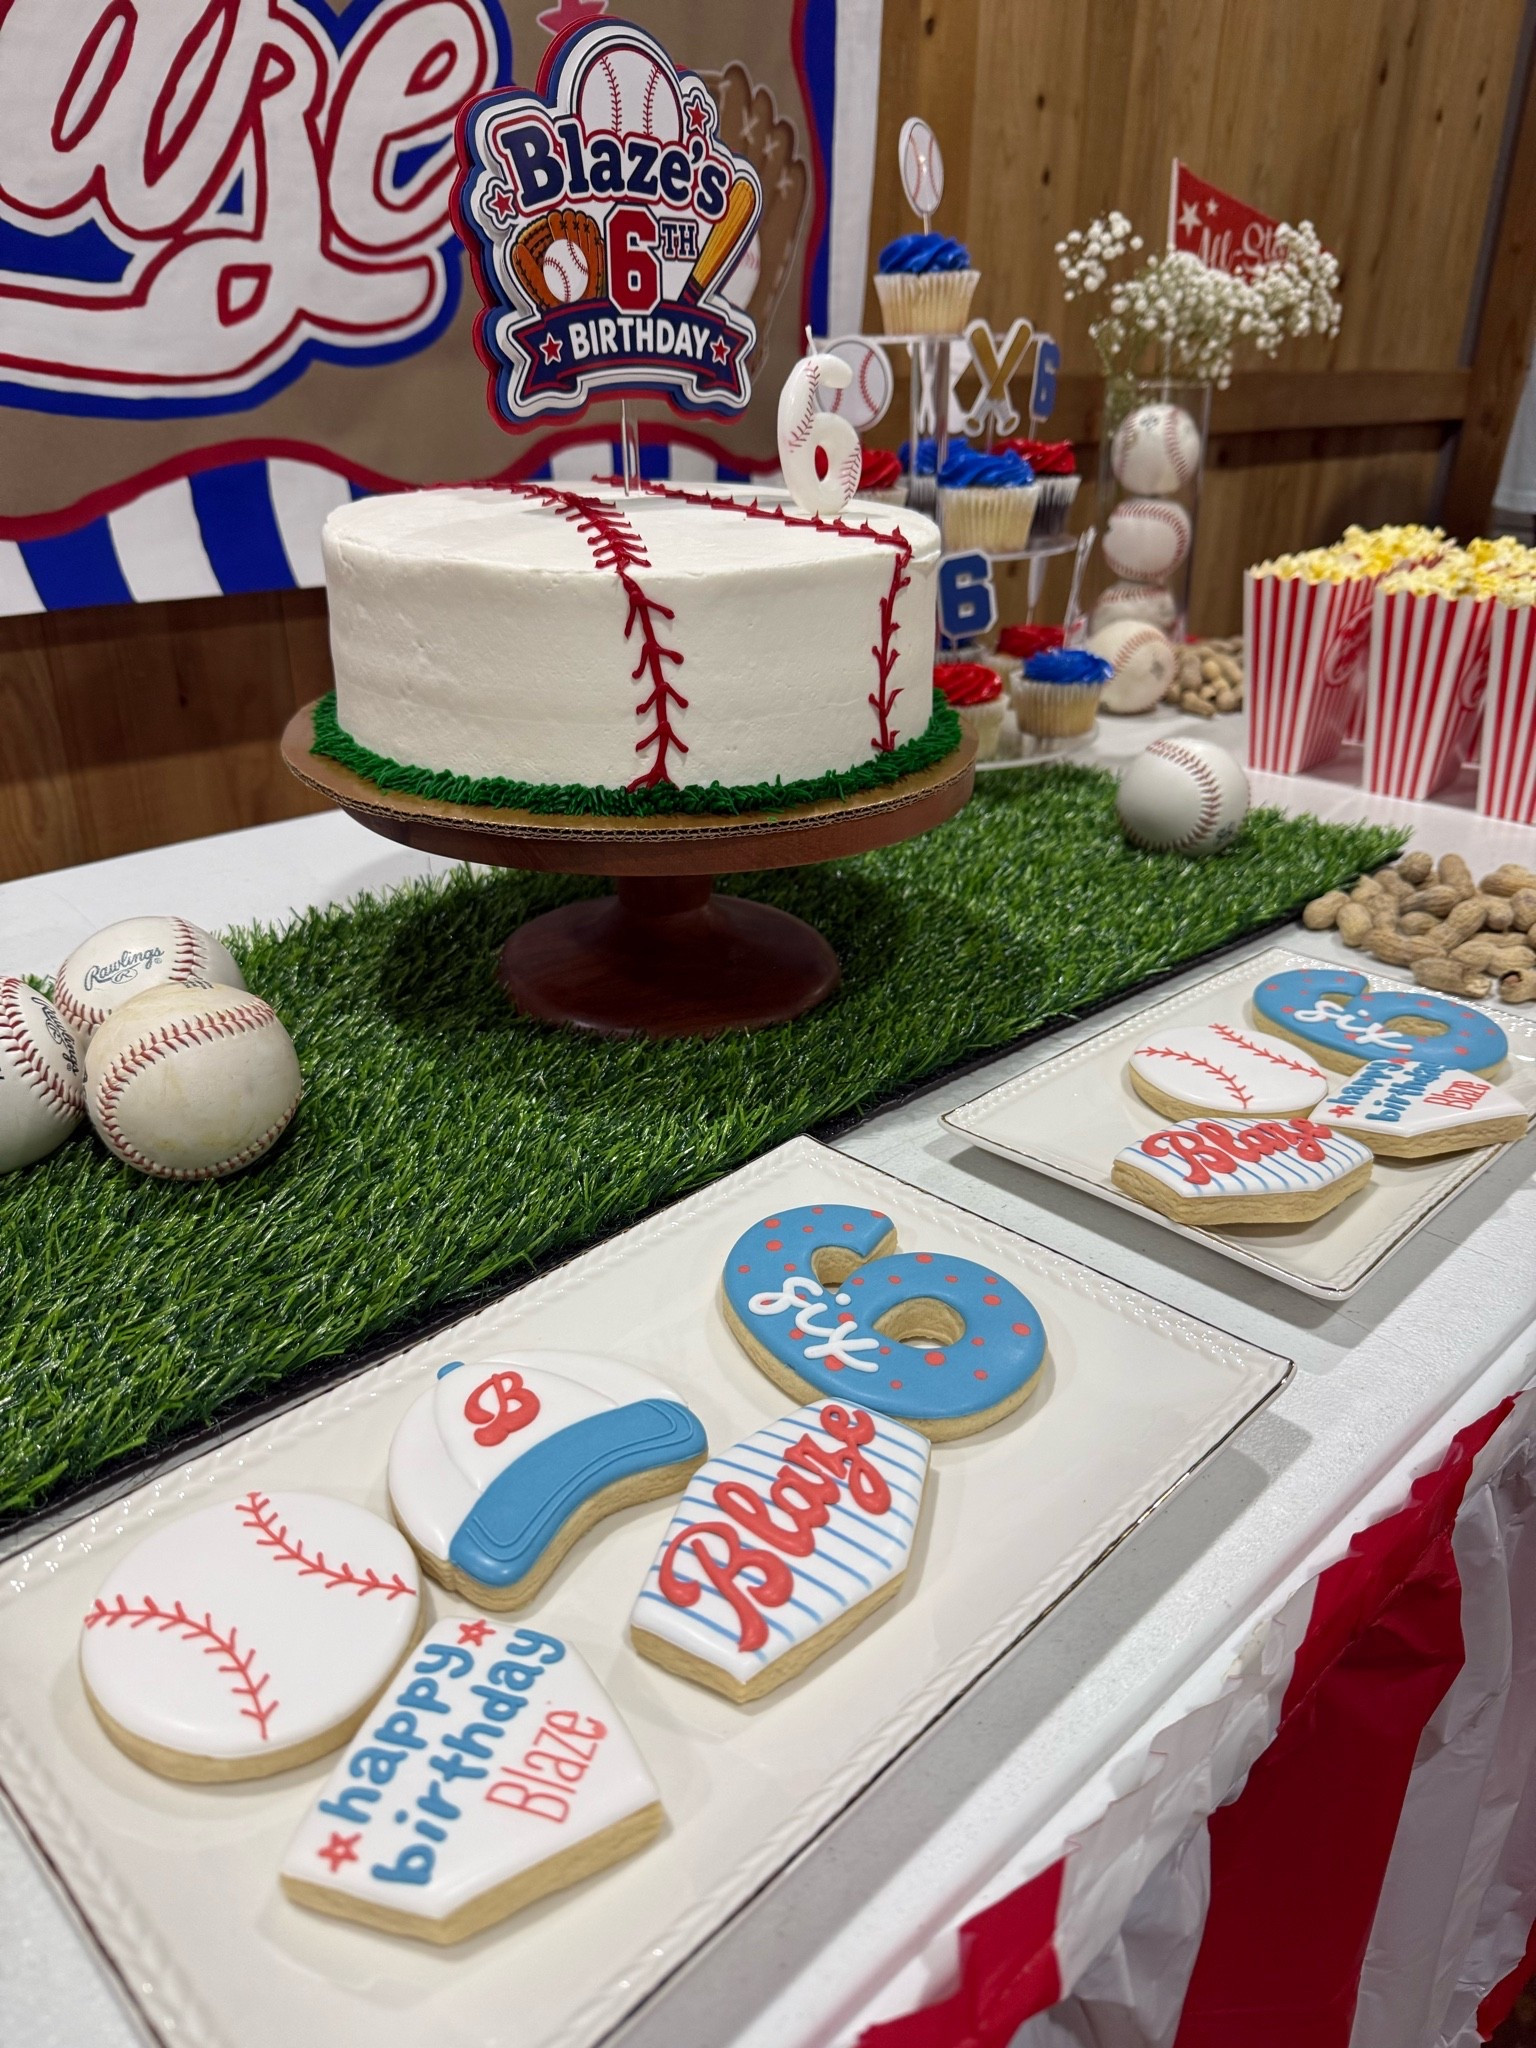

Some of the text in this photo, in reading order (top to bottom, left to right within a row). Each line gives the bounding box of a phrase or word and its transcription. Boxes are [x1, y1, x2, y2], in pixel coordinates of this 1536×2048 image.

[500, 124, 728, 216] Blaze's
[567, 316, 714, 361] BIRTHDAY
[1031, 340, 1061, 420] 6
[937, 552, 996, 638] 6
[84, 947, 165, 991] Rawlings
[1326, 1061, 1405, 1105] happy
[1423, 1080, 1491, 1110] Blaze
[1140, 1116, 1333, 1186] Blaze
[464, 1370, 541, 1447] B
[658, 1403, 892, 1653] Blaze
[318, 1642, 475, 1824] happy
[371, 1628, 566, 1886] birthday
[484, 1709, 608, 1824] Blaze
